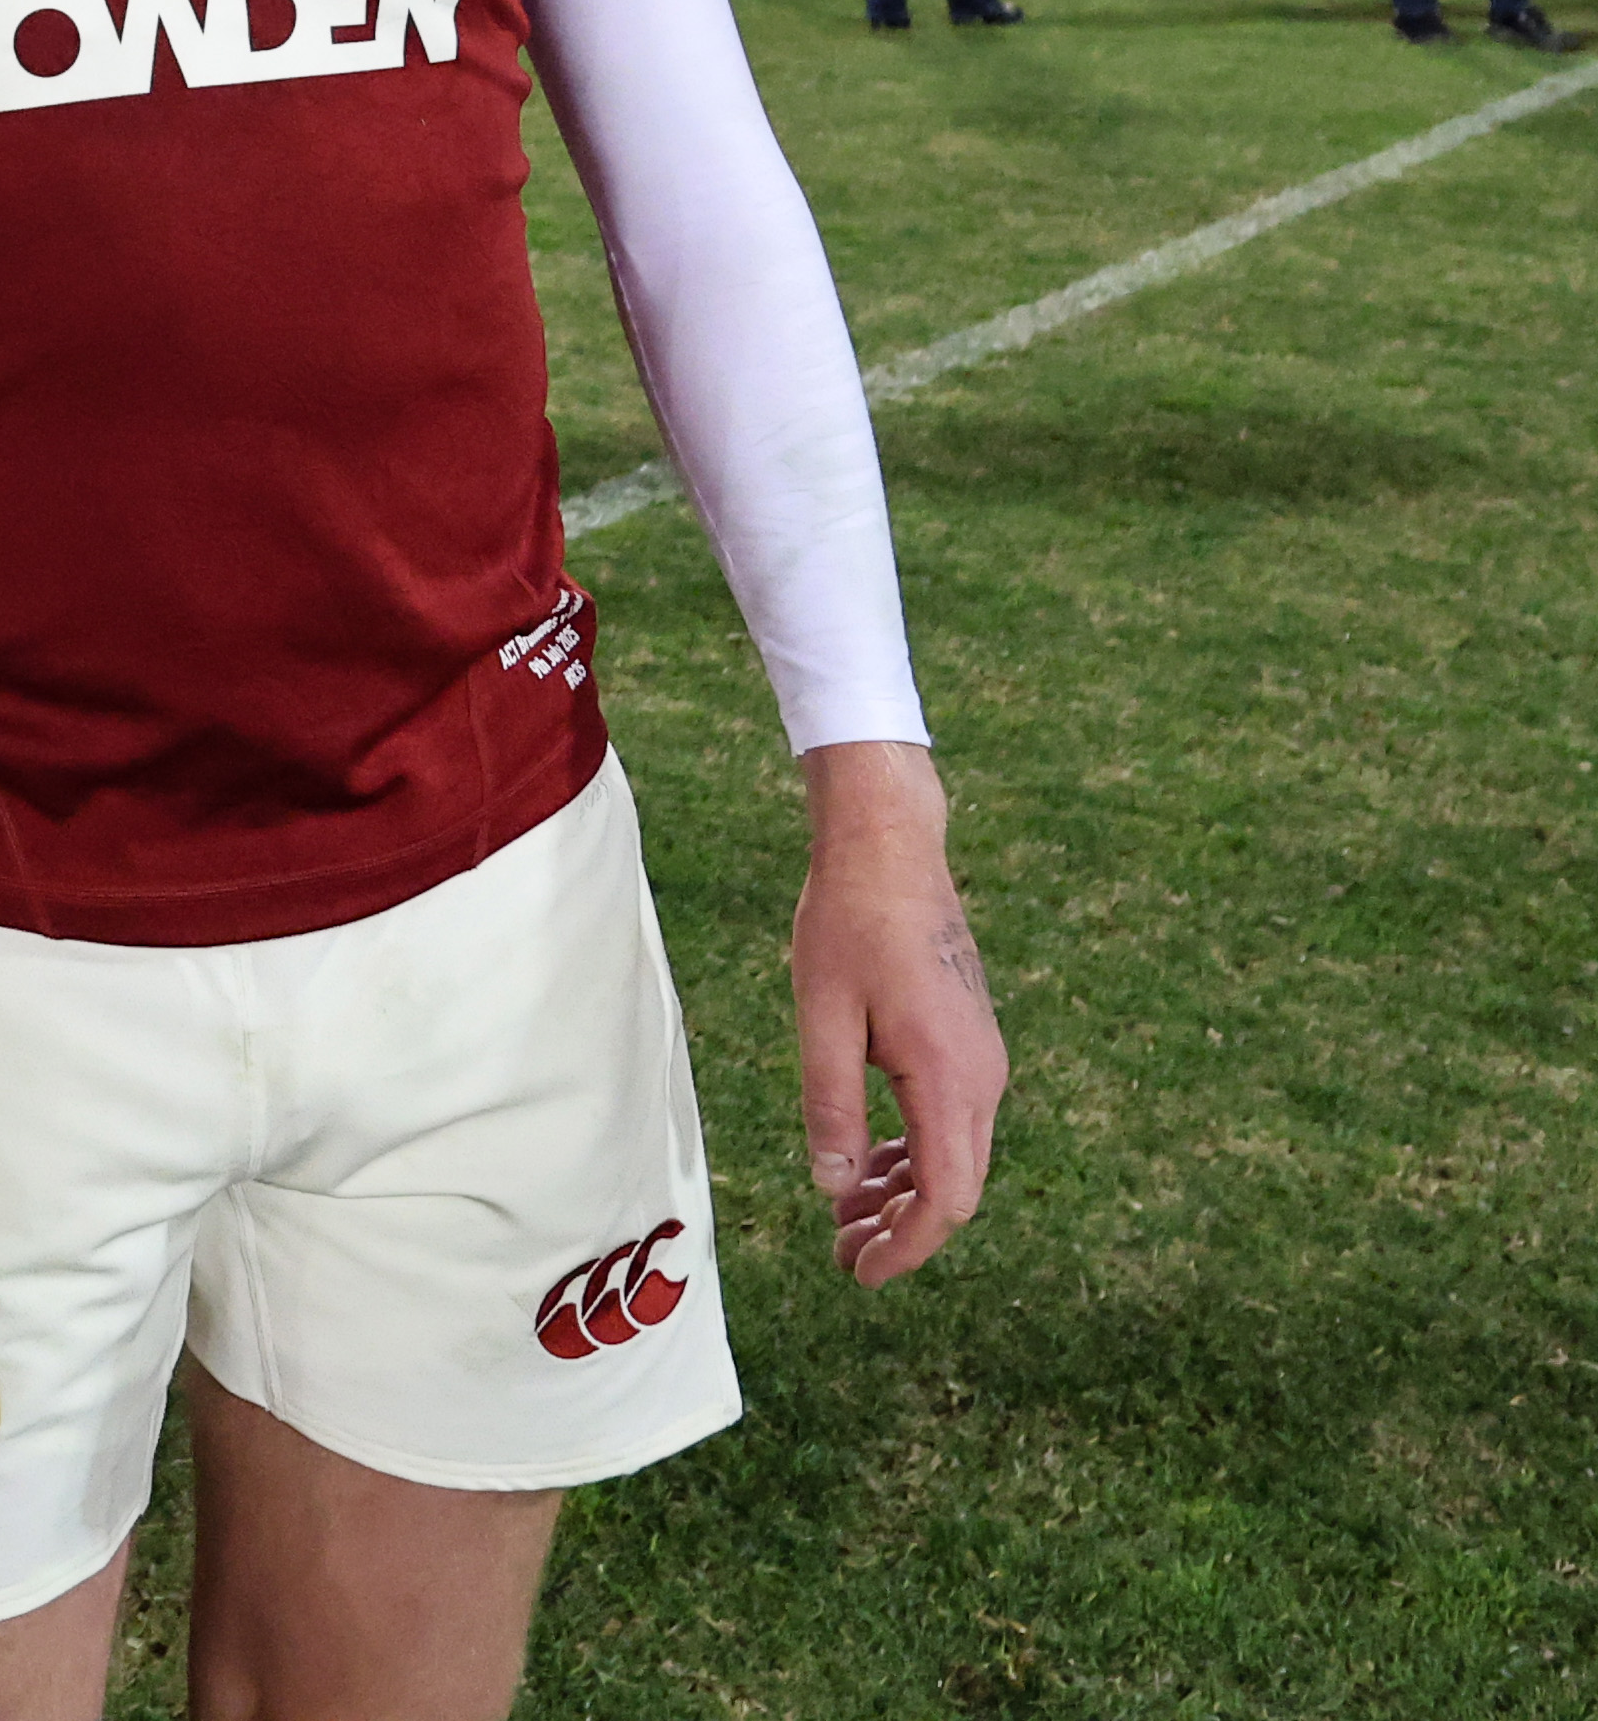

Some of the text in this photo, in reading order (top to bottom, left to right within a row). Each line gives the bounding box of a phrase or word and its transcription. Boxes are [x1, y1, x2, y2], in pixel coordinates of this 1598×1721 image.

[498, 639, 521, 671] ACT
[527, 655, 552, 680] 9th
[541, 643, 569, 668] July
